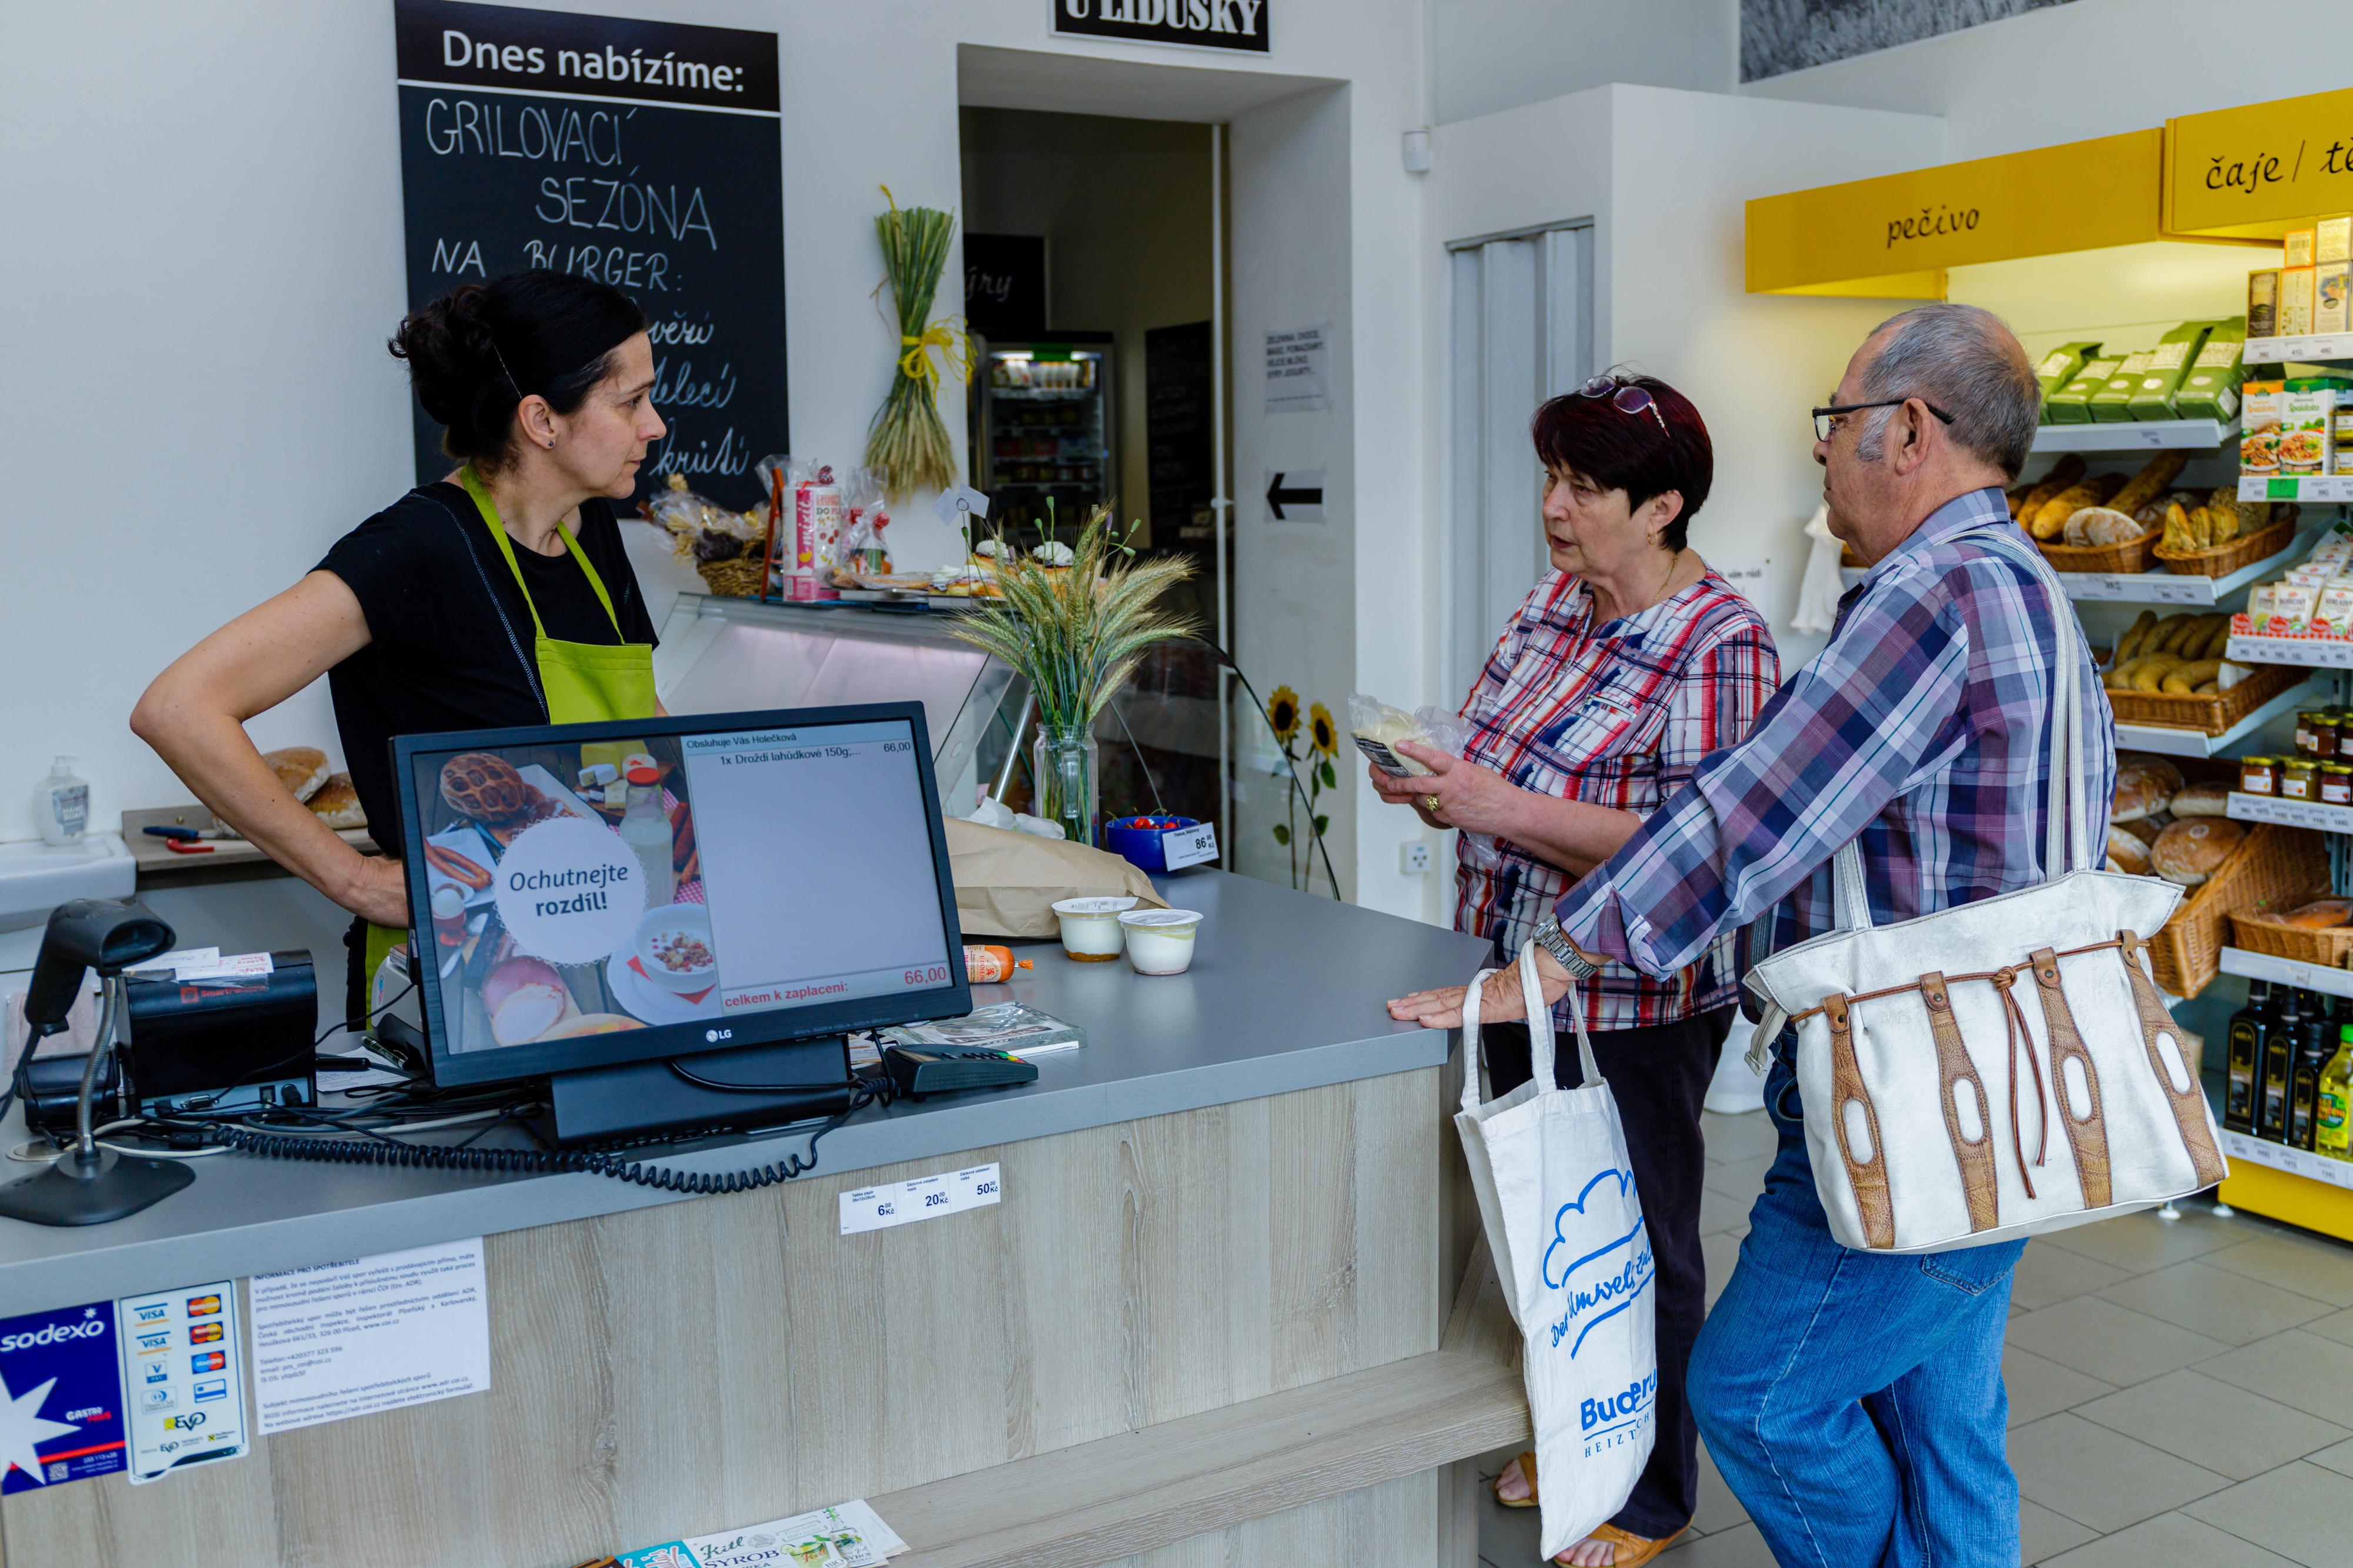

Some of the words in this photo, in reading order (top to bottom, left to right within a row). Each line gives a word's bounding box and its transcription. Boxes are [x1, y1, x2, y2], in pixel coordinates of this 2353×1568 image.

[442, 29, 546, 75] Dnes
[558, 45, 744, 92] nabízíme:
[426, 98, 638, 166] GRILOVACÍ
[2206, 151, 2284, 194] čaje
[535, 166, 718, 251] SEZÓNA
[1886, 204, 1981, 250] pečivo
[431, 238, 486, 278] NA
[965, 266, 1012, 302] ýry
[798, 501, 812, 545] mixit
[686, 737, 731, 750] Obsluhuje
[733, 735, 749, 746] Vás
[752, 732, 797, 745] Holečková
[883, 741, 911, 753] 66,00
[720, 755, 732, 765] 1x
[735, 752, 769, 765] Droždí
[1195, 837, 1207, 849] 86
[509, 864, 629, 892] Ochutnejte
[535, 892, 608, 917] rozdíl!
[725, 990, 771, 1008] celkem
[774, 989, 782, 1001] k
[785, 981, 849, 1002] zaplacení:
[904, 966, 946, 986] 66,00
[718, 1029, 732, 1040] LG
[977, 1183, 989, 1195] 50
[878, 1205, 885, 1216] 6
[925, 1194, 939, 1207] 20
[139, 1309, 165, 1320] VISA
[0, 1319, 105, 1352] sodexo
[1551, 1311, 1568, 1348] Der
[141, 1337, 166, 1348] VISA
[152, 1365, 162, 1373] V
[164, 1412, 206, 1431] REVO
[704, 1550, 780, 1568] SYROB
